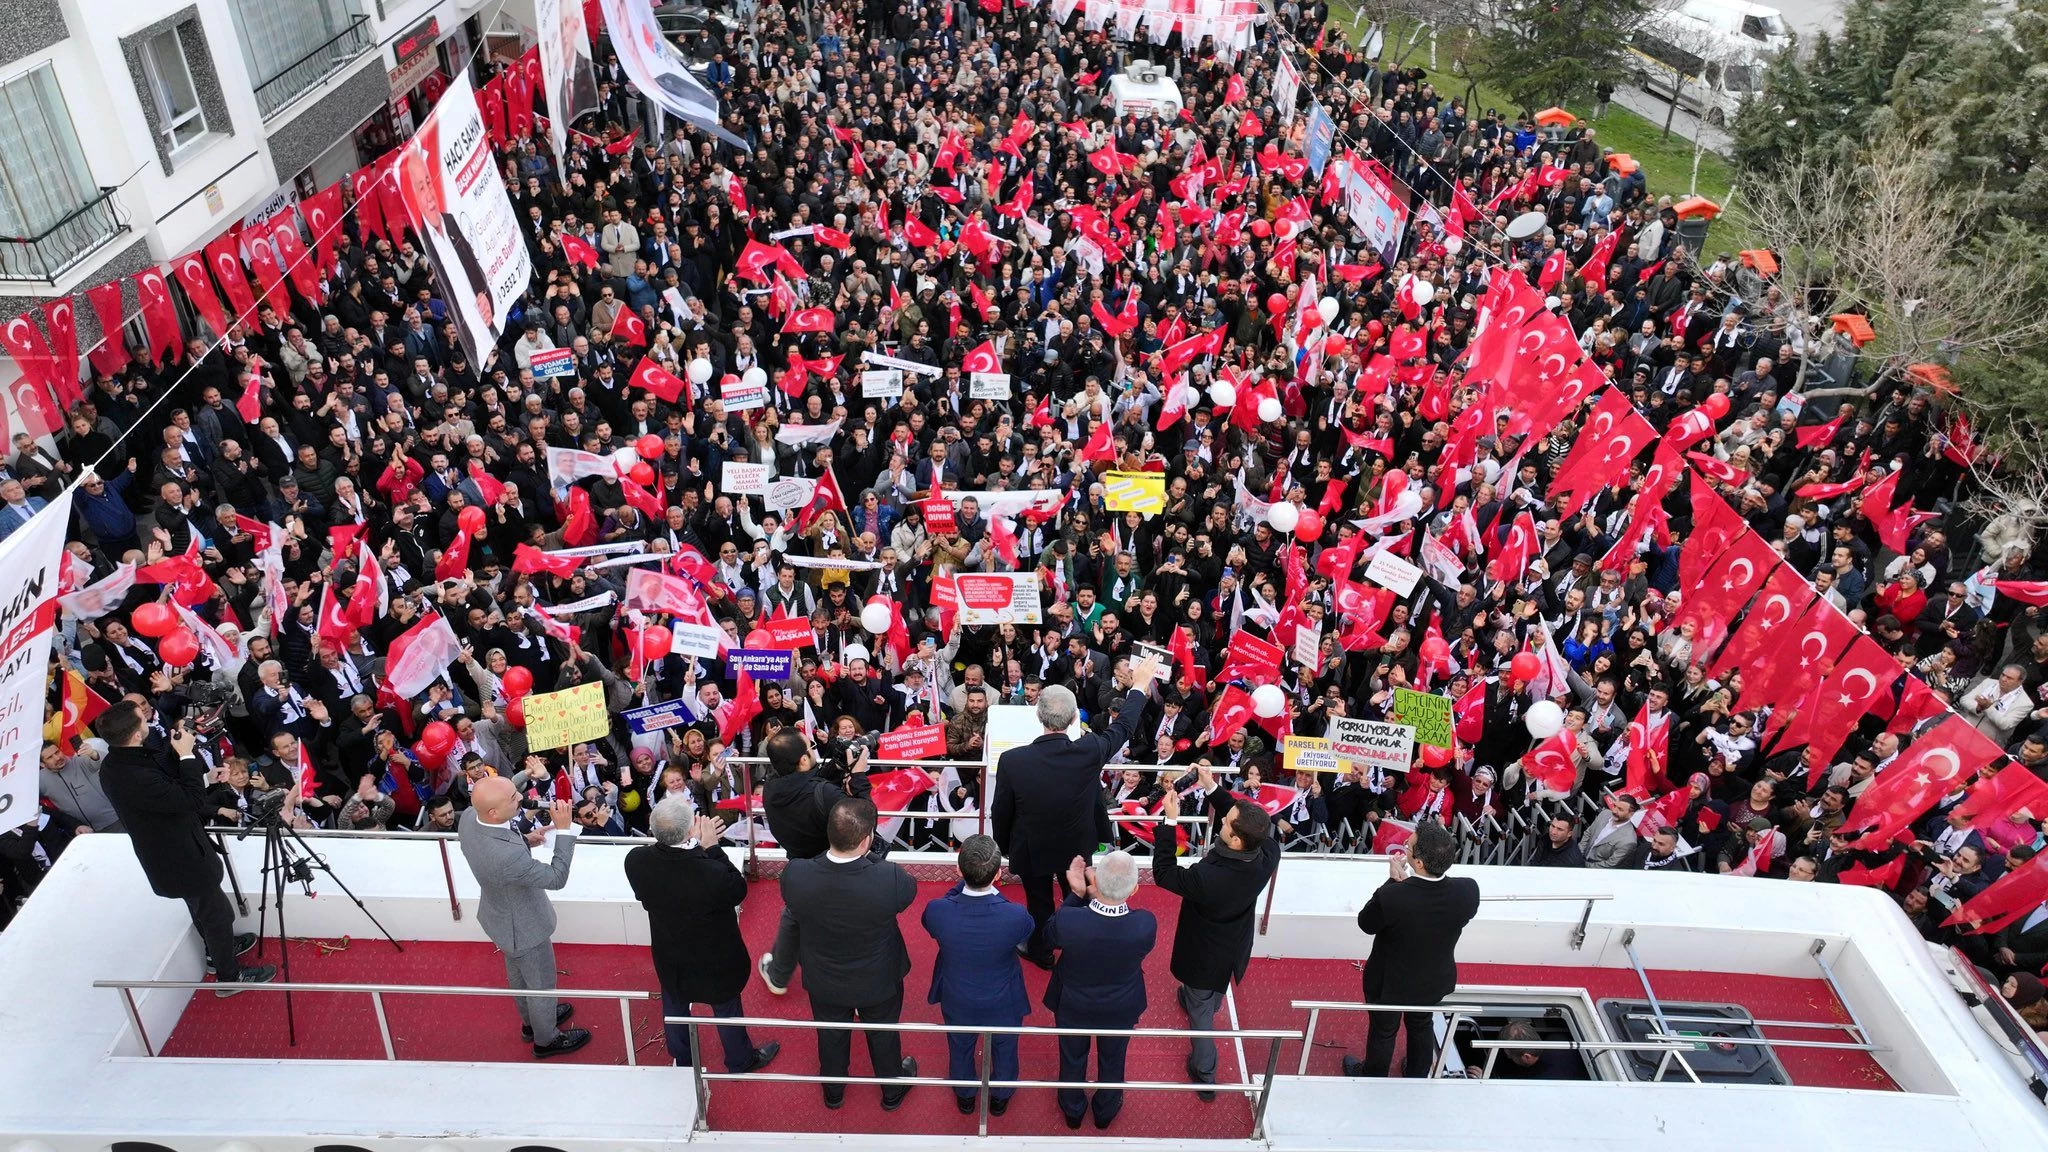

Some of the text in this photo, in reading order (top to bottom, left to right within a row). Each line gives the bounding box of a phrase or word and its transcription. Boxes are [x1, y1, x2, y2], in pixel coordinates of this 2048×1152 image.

[444, 138, 465, 175] HACI
[544, 366, 565, 375] ORTAK
[926, 504, 951, 512] DOĞRU
[928, 513, 952, 521] DUVAR
[776, 631, 810, 641] BAŞKAN
[743, 655, 774, 663] Ankara'ya
[0, 647, 32, 684] AYI
[770, 664, 784, 672] Aşık
[626, 702, 682, 720] PARSEL PARSEL
[1396, 702, 1443, 722] UMUDU
[880, 727, 940, 743] Verdiğimiz Emaneti
[912, 736, 939, 745] Koruyan
[1288, 740, 1315, 749] PARSEL
[901, 748, 924, 757] BAŞKAN
[1296, 758, 1336, 768] ÜRETİYORUZ
